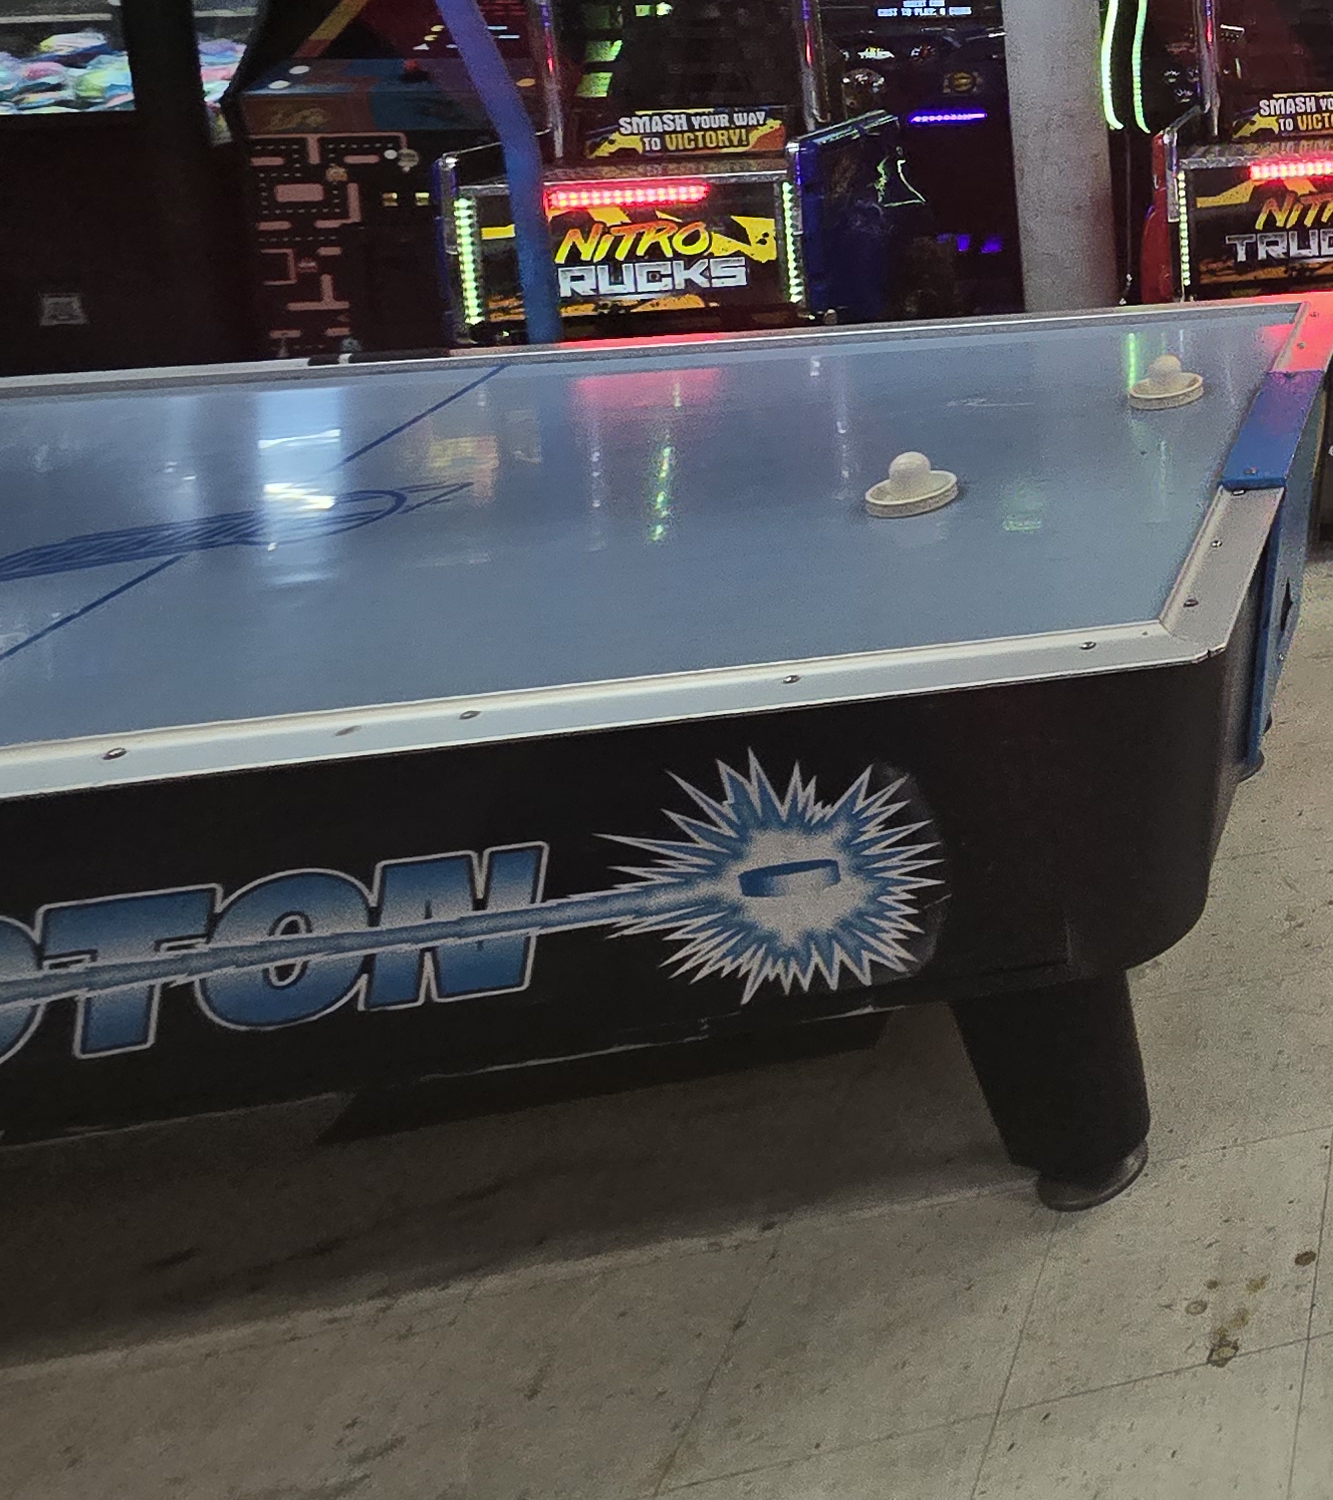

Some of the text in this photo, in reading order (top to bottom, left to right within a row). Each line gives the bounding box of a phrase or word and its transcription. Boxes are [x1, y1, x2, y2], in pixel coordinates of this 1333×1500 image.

[1259, 96, 1317, 116] SMASH
[618, 111, 766, 134] SMASH YOUR WAY
[1278, 118, 1294, 131] TO
[643, 129, 748, 151] TO VICTORY!
[554, 221, 711, 264] NITRO
[557, 257, 748, 298] RUCKS
[0, 841, 549, 1064] TON
